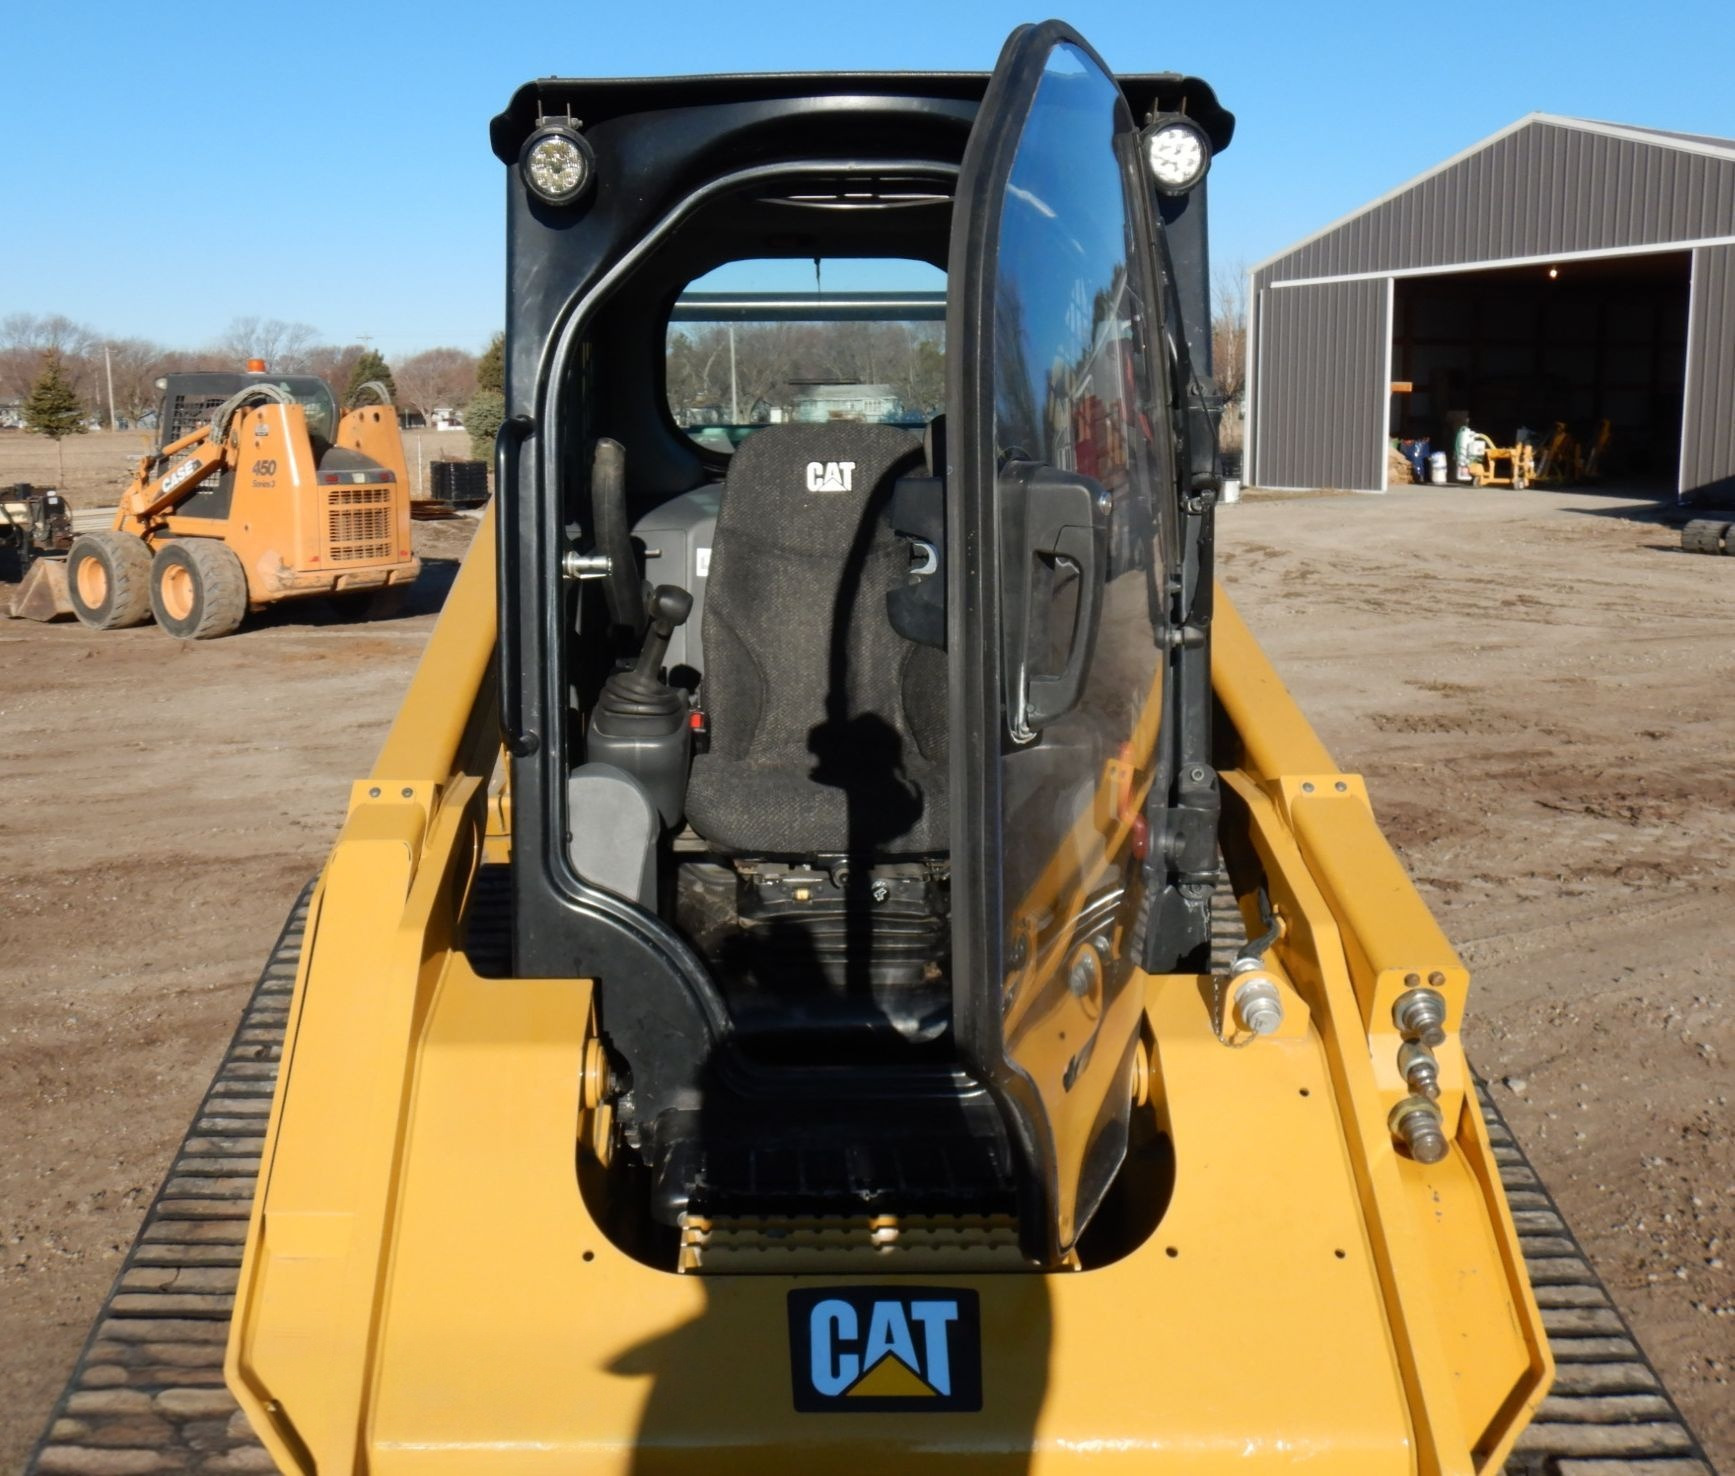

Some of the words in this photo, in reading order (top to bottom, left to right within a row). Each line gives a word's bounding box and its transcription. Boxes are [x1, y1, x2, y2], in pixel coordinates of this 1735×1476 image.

[162, 459, 197, 493] CASE
[251, 459, 277, 476] 450
[806, 461, 856, 492] CAT
[810, 1299, 959, 1397] CAT
